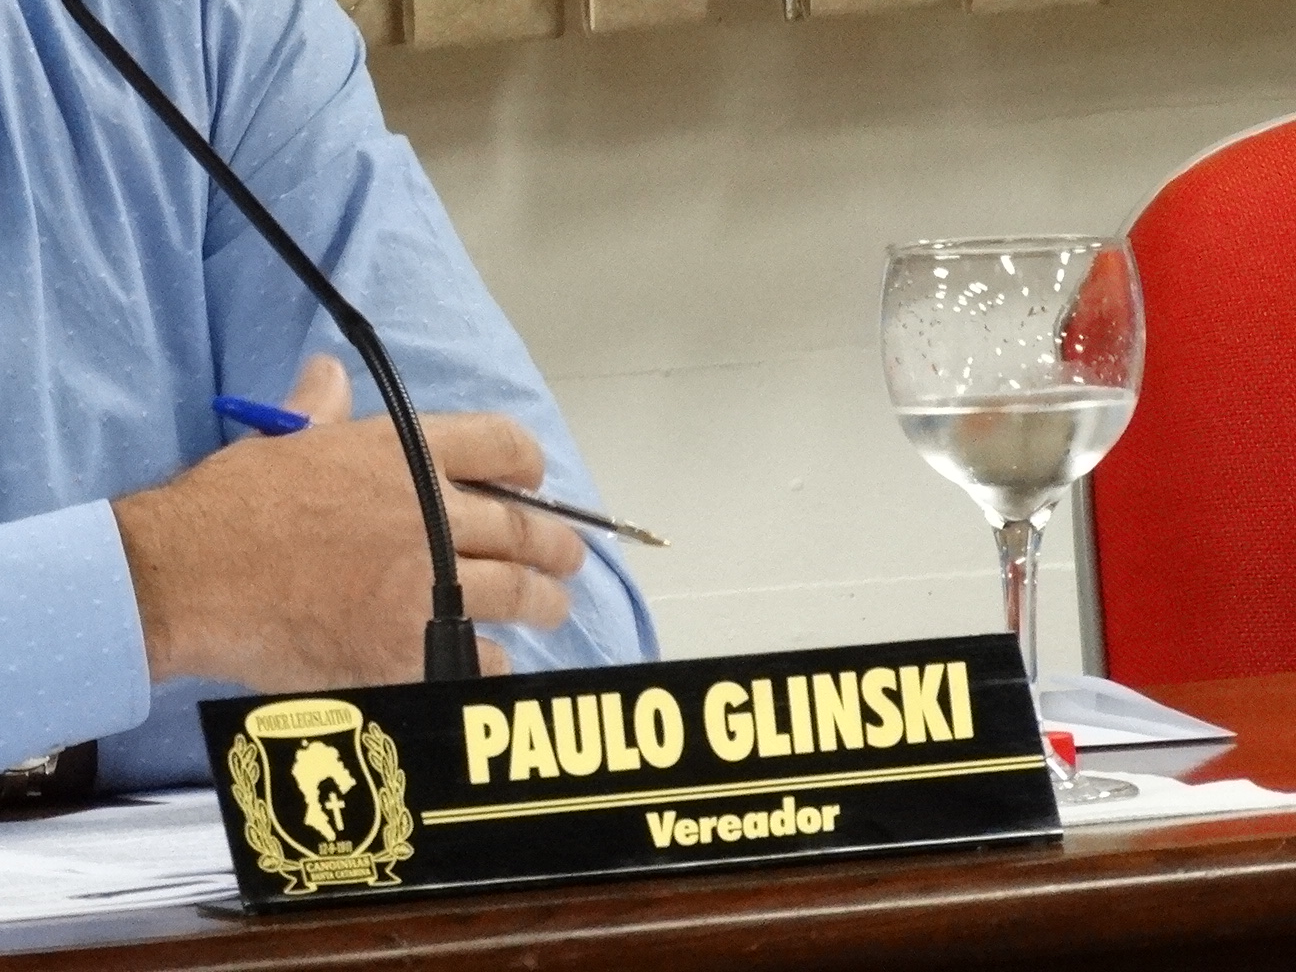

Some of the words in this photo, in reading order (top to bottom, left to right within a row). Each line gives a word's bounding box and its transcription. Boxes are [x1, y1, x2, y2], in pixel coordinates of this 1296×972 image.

[255, 713, 290, 732] PODER
[463, 687, 684, 785] PAULO
[704, 661, 974, 762] GLINSKI
[646, 796, 840, 848] Vereador
